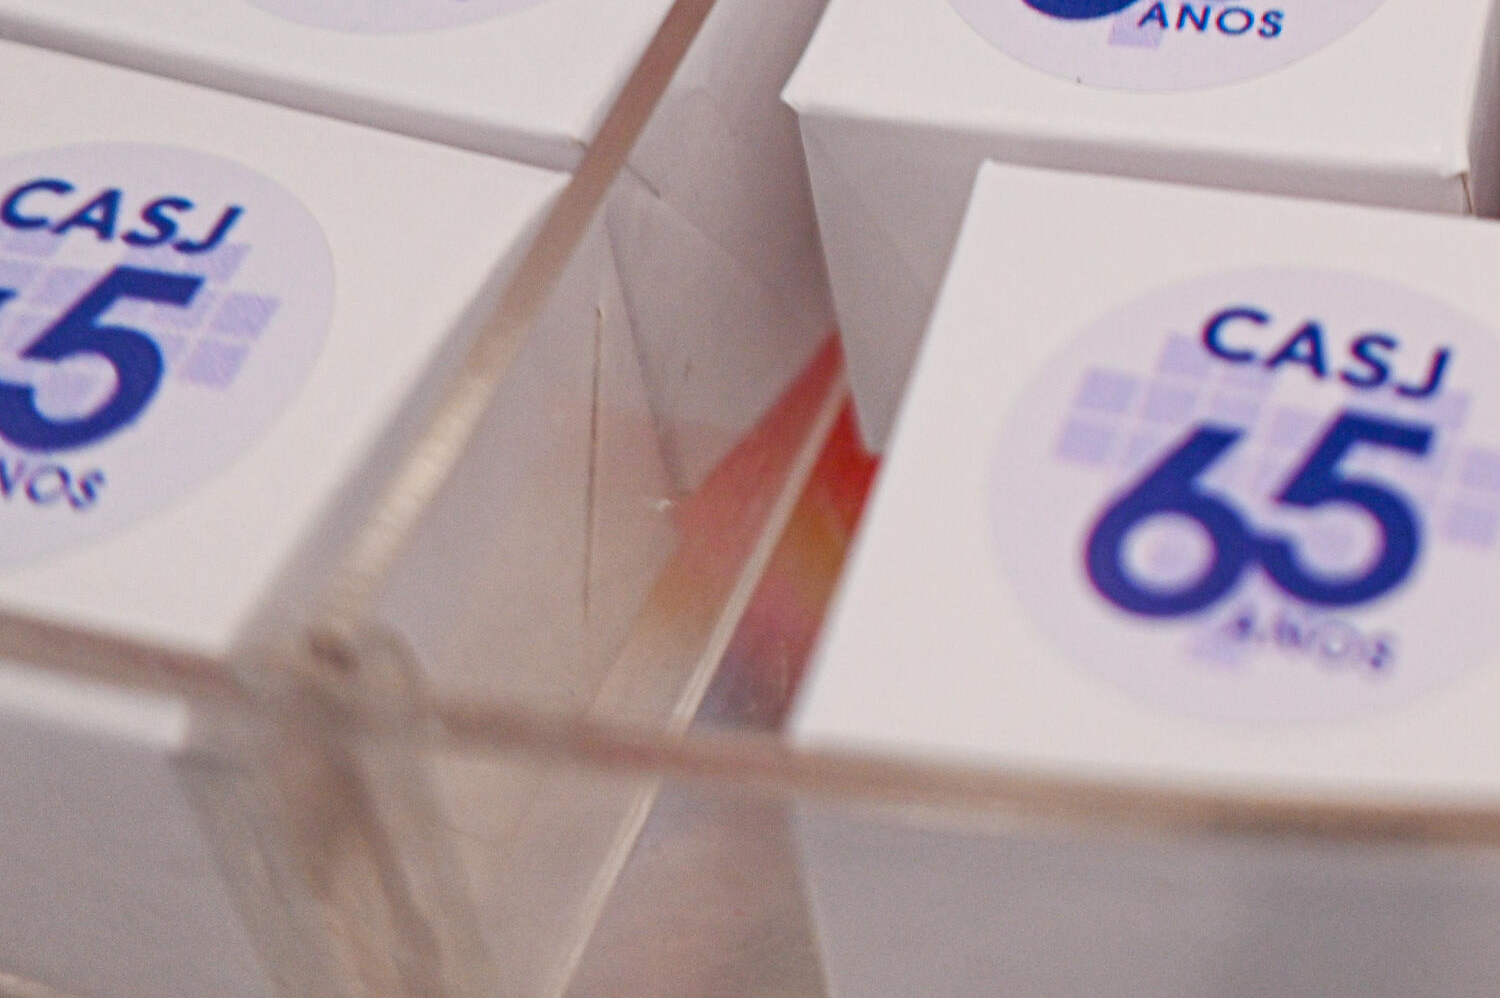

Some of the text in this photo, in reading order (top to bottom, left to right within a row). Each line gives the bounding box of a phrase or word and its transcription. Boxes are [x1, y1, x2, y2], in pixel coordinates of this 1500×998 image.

[1137, 1, 1285, 39] ANOS
[0, 178, 244, 255] CASJ
[1202, 306, 1452, 400] CASJ
[1084, 408, 1436, 619] 65
